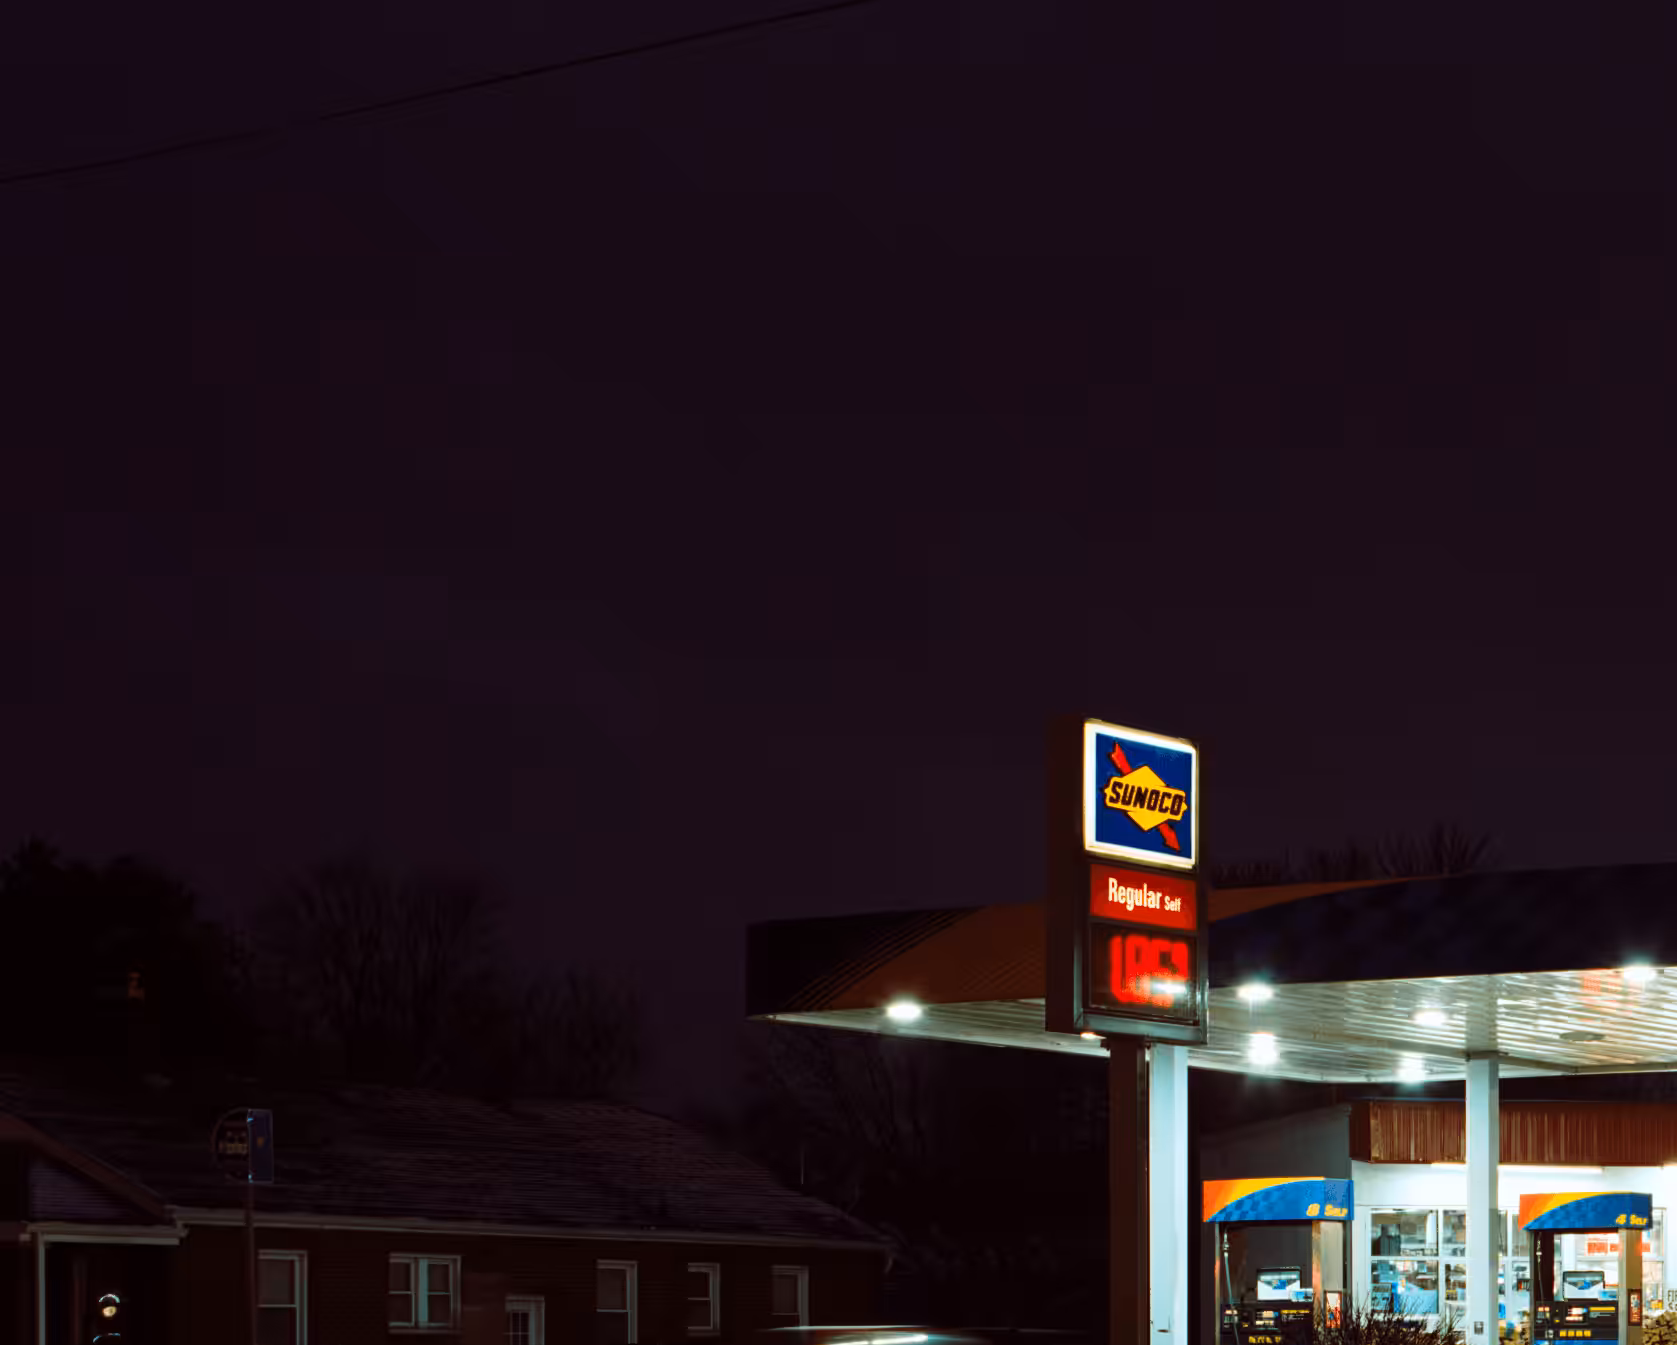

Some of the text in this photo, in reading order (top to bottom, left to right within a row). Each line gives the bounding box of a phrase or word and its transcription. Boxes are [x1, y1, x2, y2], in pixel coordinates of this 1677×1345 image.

[1109, 780, 1184, 817] SUNOCO
[1108, 877, 1181, 913] Regular Self
